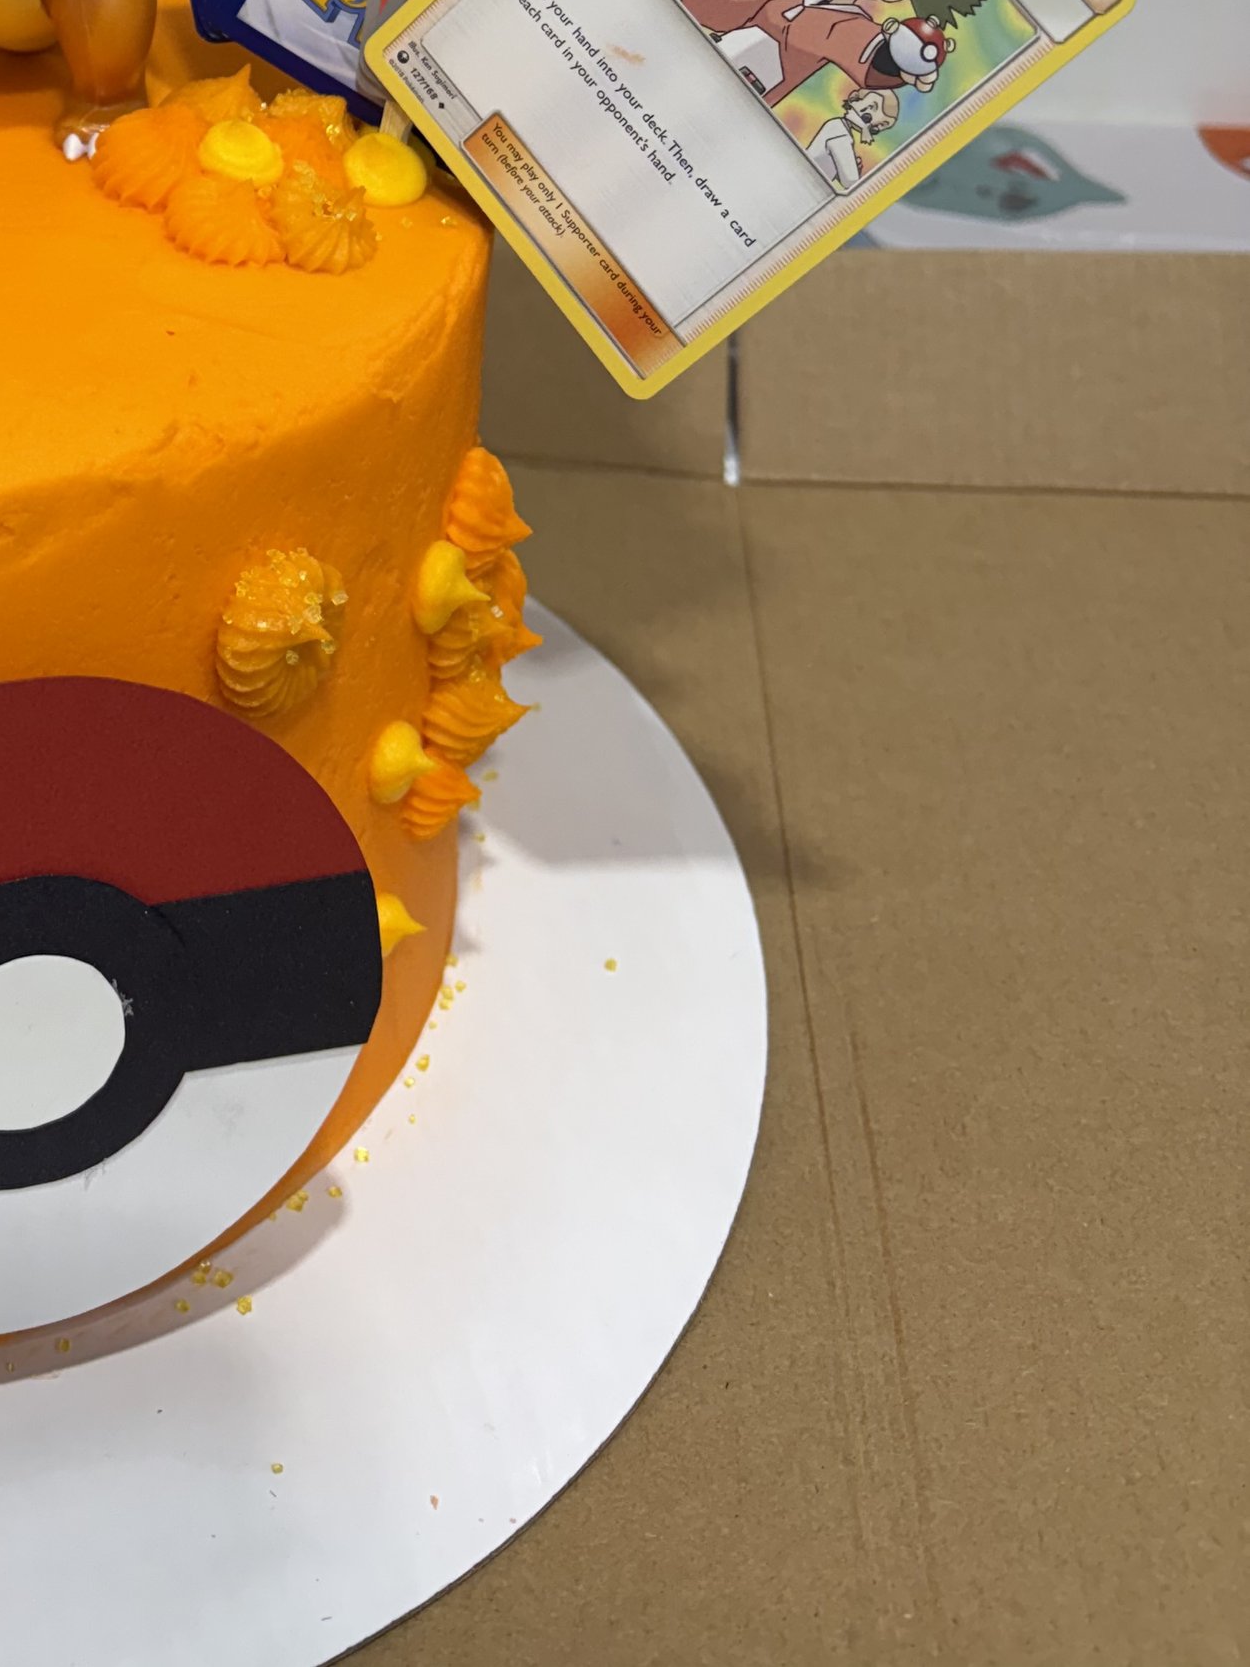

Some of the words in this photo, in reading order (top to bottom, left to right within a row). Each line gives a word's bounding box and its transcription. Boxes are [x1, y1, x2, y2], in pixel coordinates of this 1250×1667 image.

[410, 67, 438, 100] 127/168
[421, 56, 433, 71] Ken
[431, 70, 457, 100] Sugimori
[540, 22, 570, 49] card
[562, 45, 574, 62] in
[570, 61, 598, 87] your
[596, 89, 650, 152] opponent's
[647, 150, 676, 185] hand.
[547, 0, 573, 27] your
[572, 26, 599, 57] hand
[597, 57, 618, 83] into
[615, 83, 643, 110] your
[642, 112, 669, 145] deck.
[668, 140, 694, 178] Then,
[695, 177, 722, 206] draw
[720, 209, 730, 219] a
[729, 220, 757, 247] card
[481, 133, 500, 155] turn
[496, 154, 525, 185] (before
[520, 184, 541, 204] your
[538, 205, 567, 239] attack).
[492, 122, 508, 144] You
[506, 142, 522, 163] may
[520, 163, 539, 182] play
[538, 182, 557, 203] only
[561, 209, 601, 257] Supporter
[599, 259, 620, 281] card
[617, 281, 643, 314] during
[638, 312, 662, 335] your
